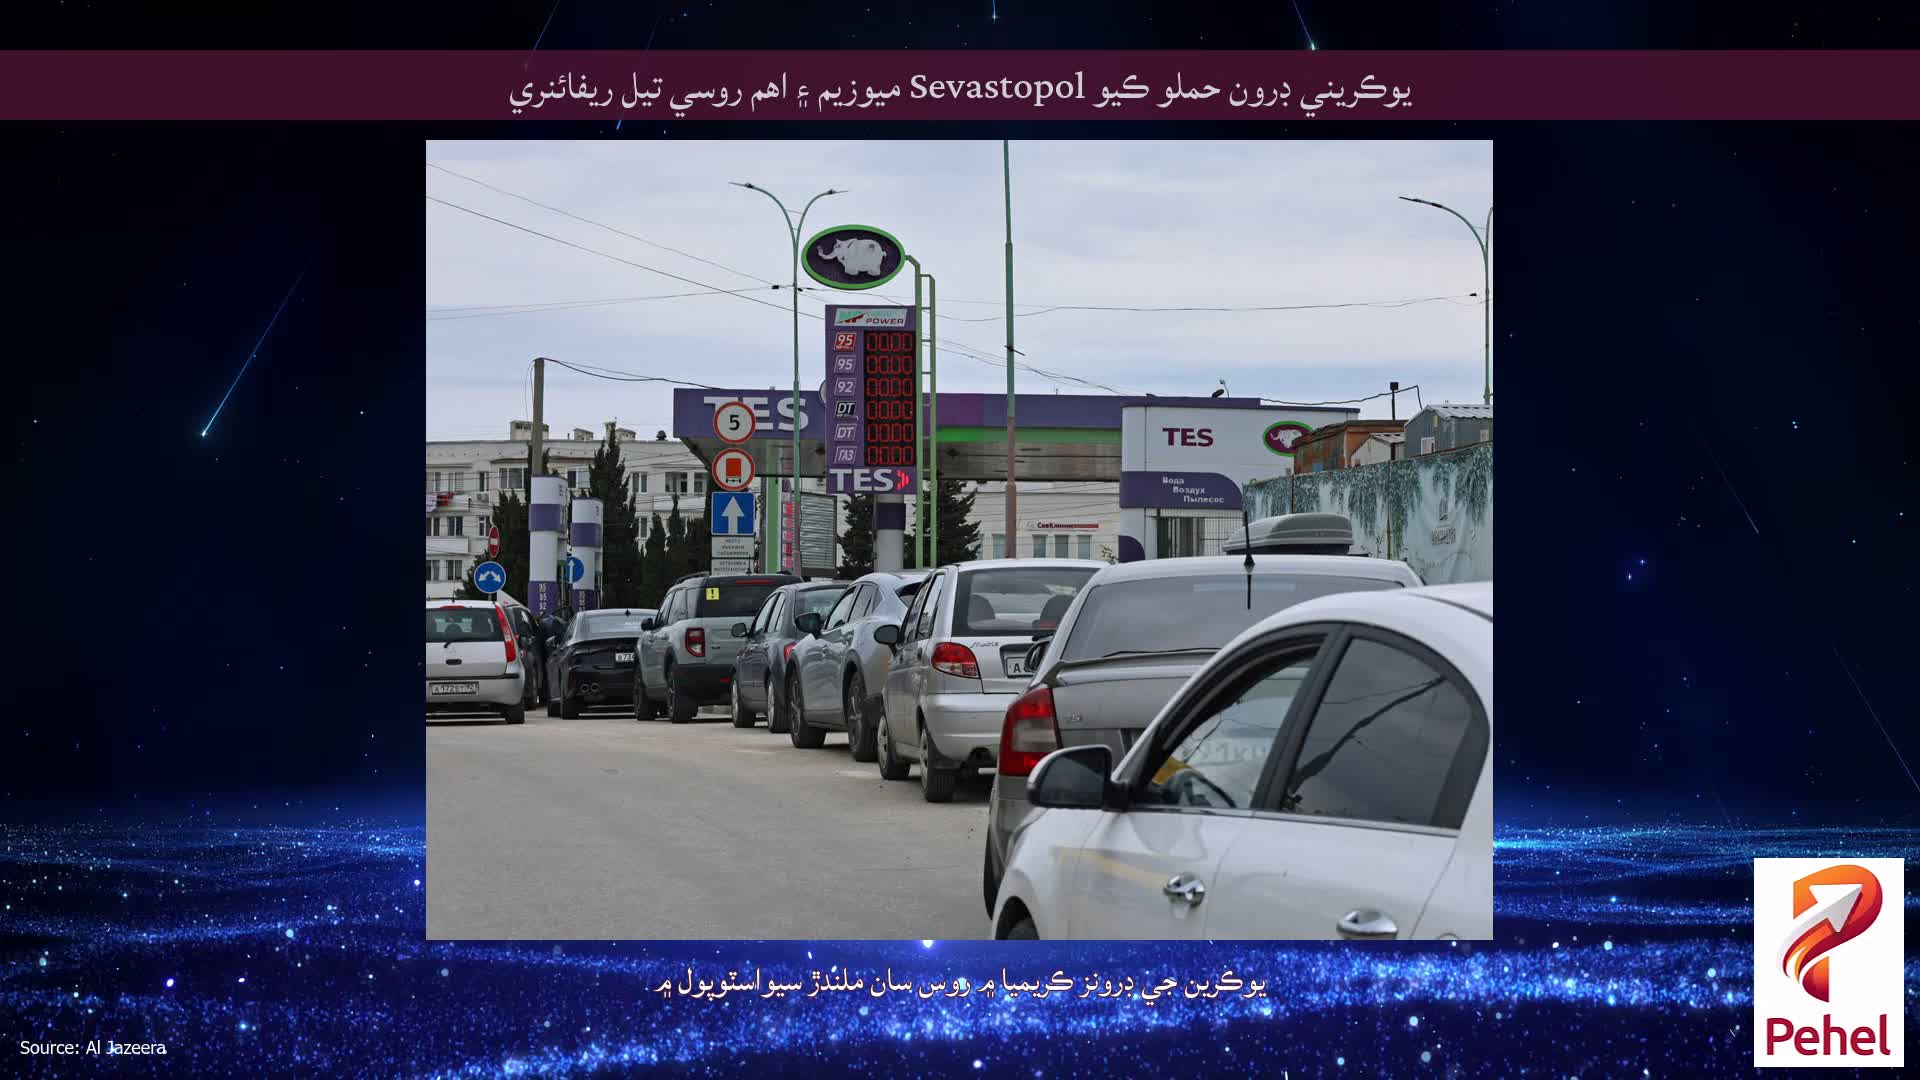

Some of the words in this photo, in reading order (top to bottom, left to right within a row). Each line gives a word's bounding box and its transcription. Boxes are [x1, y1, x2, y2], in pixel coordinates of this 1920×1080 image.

[866, 317, 904, 325] POWER
[838, 335, 853, 346] 95
[838, 358, 853, 370] 95
[838, 381, 853, 393] 92
[837, 402, 855, 414] DT
[729, 414, 740, 430] 5
[837, 427, 855, 439] DT
[1162, 427, 1214, 447] TES
[838, 449, 854, 461] ГАЗ
[829, 468, 894, 492] TES
[1162, 476, 1185, 485] Вода
[1173, 486, 1206, 495] Воздух
[1184, 495, 1224, 503] Пылесос
